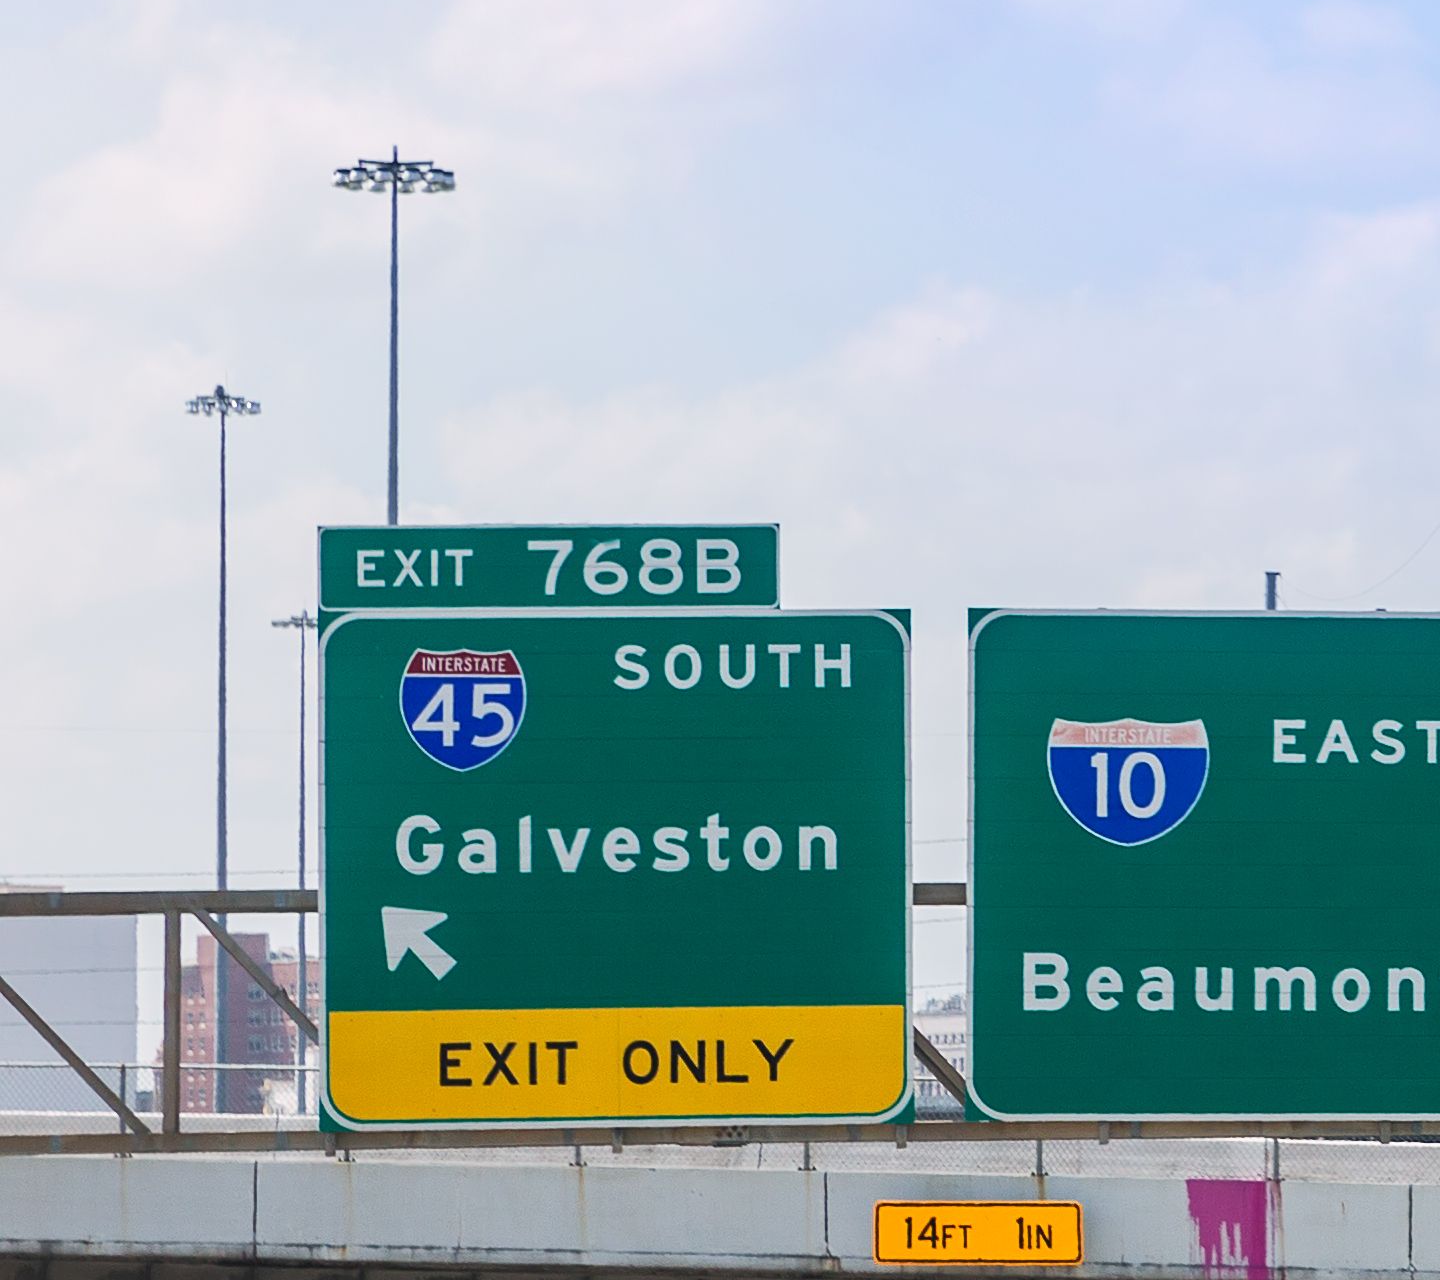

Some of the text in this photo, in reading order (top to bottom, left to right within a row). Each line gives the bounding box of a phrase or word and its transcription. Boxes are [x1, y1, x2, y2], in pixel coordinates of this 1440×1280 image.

[357, 539, 741, 595] EXIT 768B
[422, 657, 506, 672] INTERSTATE
[614, 644, 850, 689] SOUTH
[412, 684, 514, 747] 45
[1085, 727, 1172, 743] INTERSTATE
[1091, 752, 1165, 818] 10
[396, 814, 837, 874] Galveston
[440, 1039, 793, 1086] EXIT ONLY
[905, 1217, 1053, 1249] 14FT 1IN
